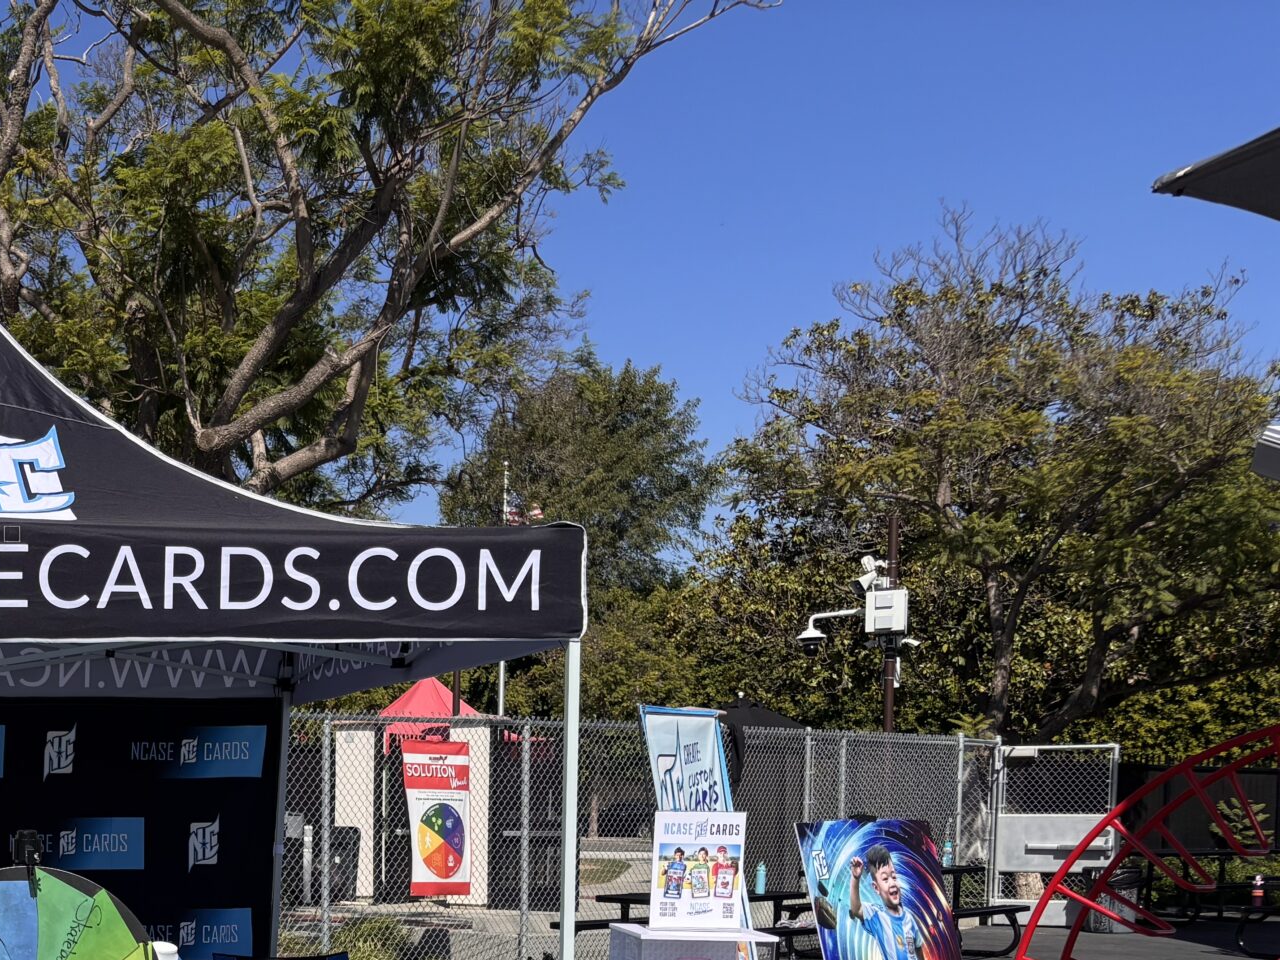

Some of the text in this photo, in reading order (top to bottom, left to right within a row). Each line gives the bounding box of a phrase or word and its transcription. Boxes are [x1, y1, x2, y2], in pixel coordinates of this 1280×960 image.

[131, 741, 174, 761] NCASE
[203, 741, 250, 761] CARDS
[683, 742, 702, 765] CREATE:
[406, 764, 456, 777] SOLUTION
[688, 768, 715, 789] CUSTOM
[689, 780, 719, 812] CARDS
[663, 822, 693, 836] NCASE
[710, 823, 740, 836] CARDS
[83, 833, 128, 853] CARDS
[202, 925, 239, 944] CARDS
